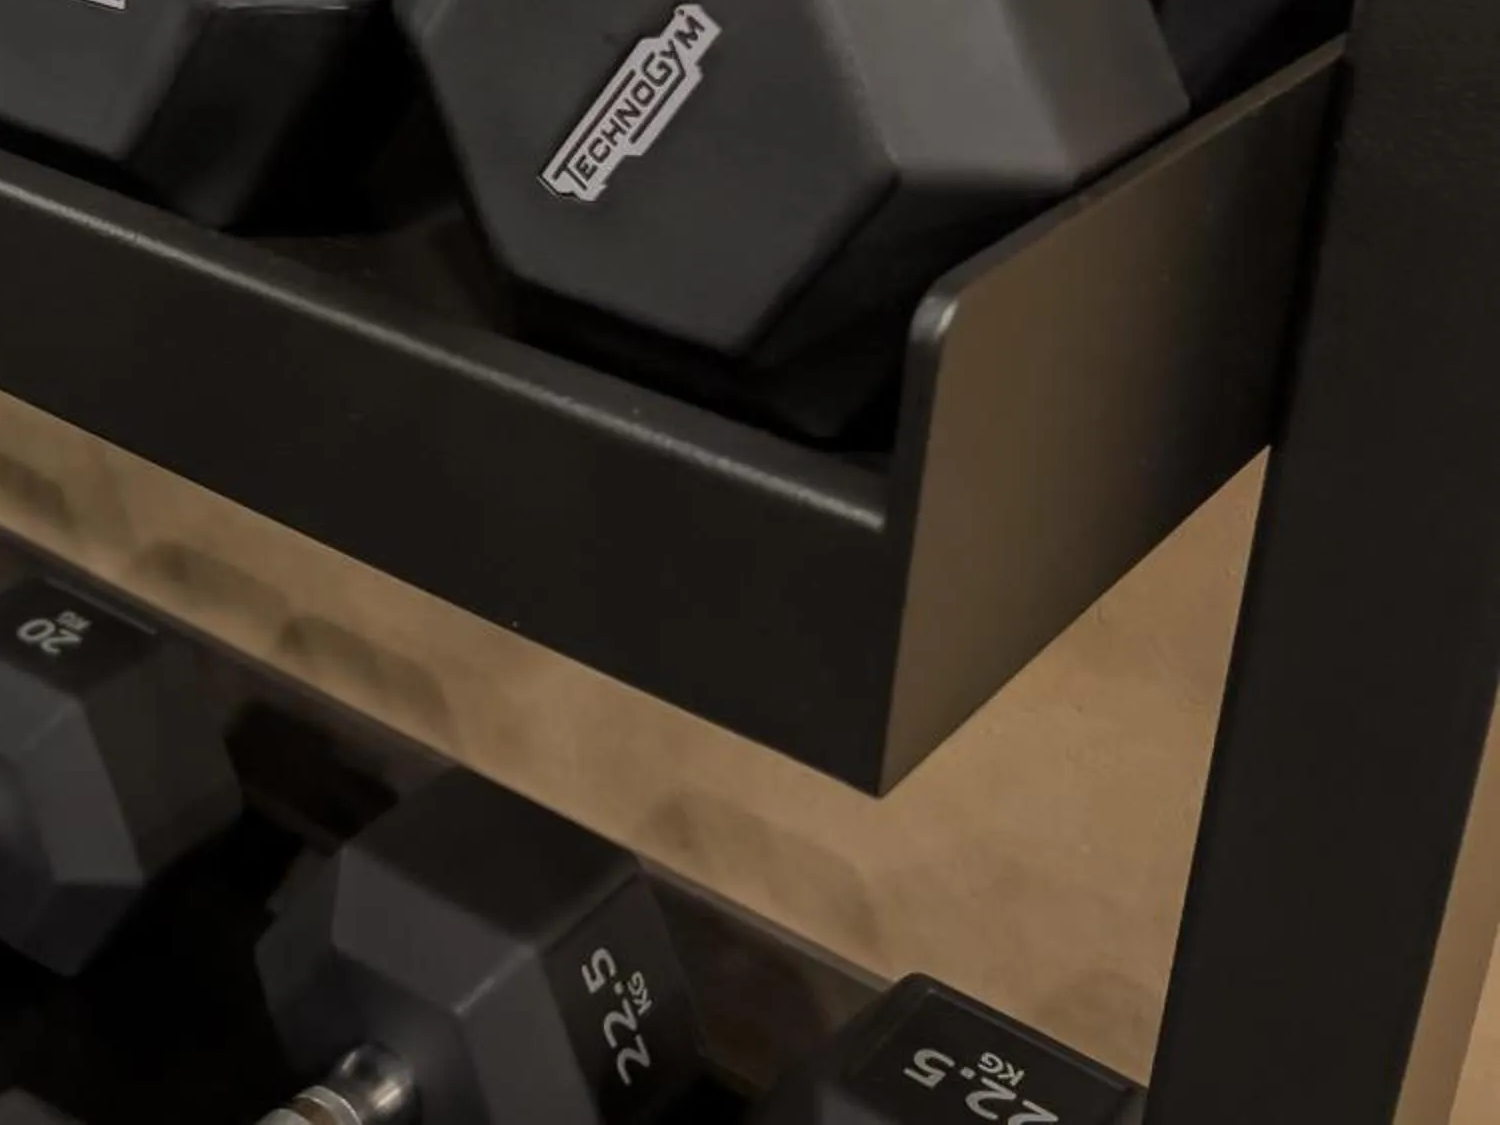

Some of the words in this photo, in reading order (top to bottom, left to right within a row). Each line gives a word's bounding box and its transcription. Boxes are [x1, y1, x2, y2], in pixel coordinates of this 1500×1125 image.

[543, 6, 715, 198] TECHNOGYM
[17, 618, 84, 653] 20
[627, 971, 654, 1016] KG
[581, 948, 651, 1086] 22.5
[978, 1051, 1025, 1087] KG
